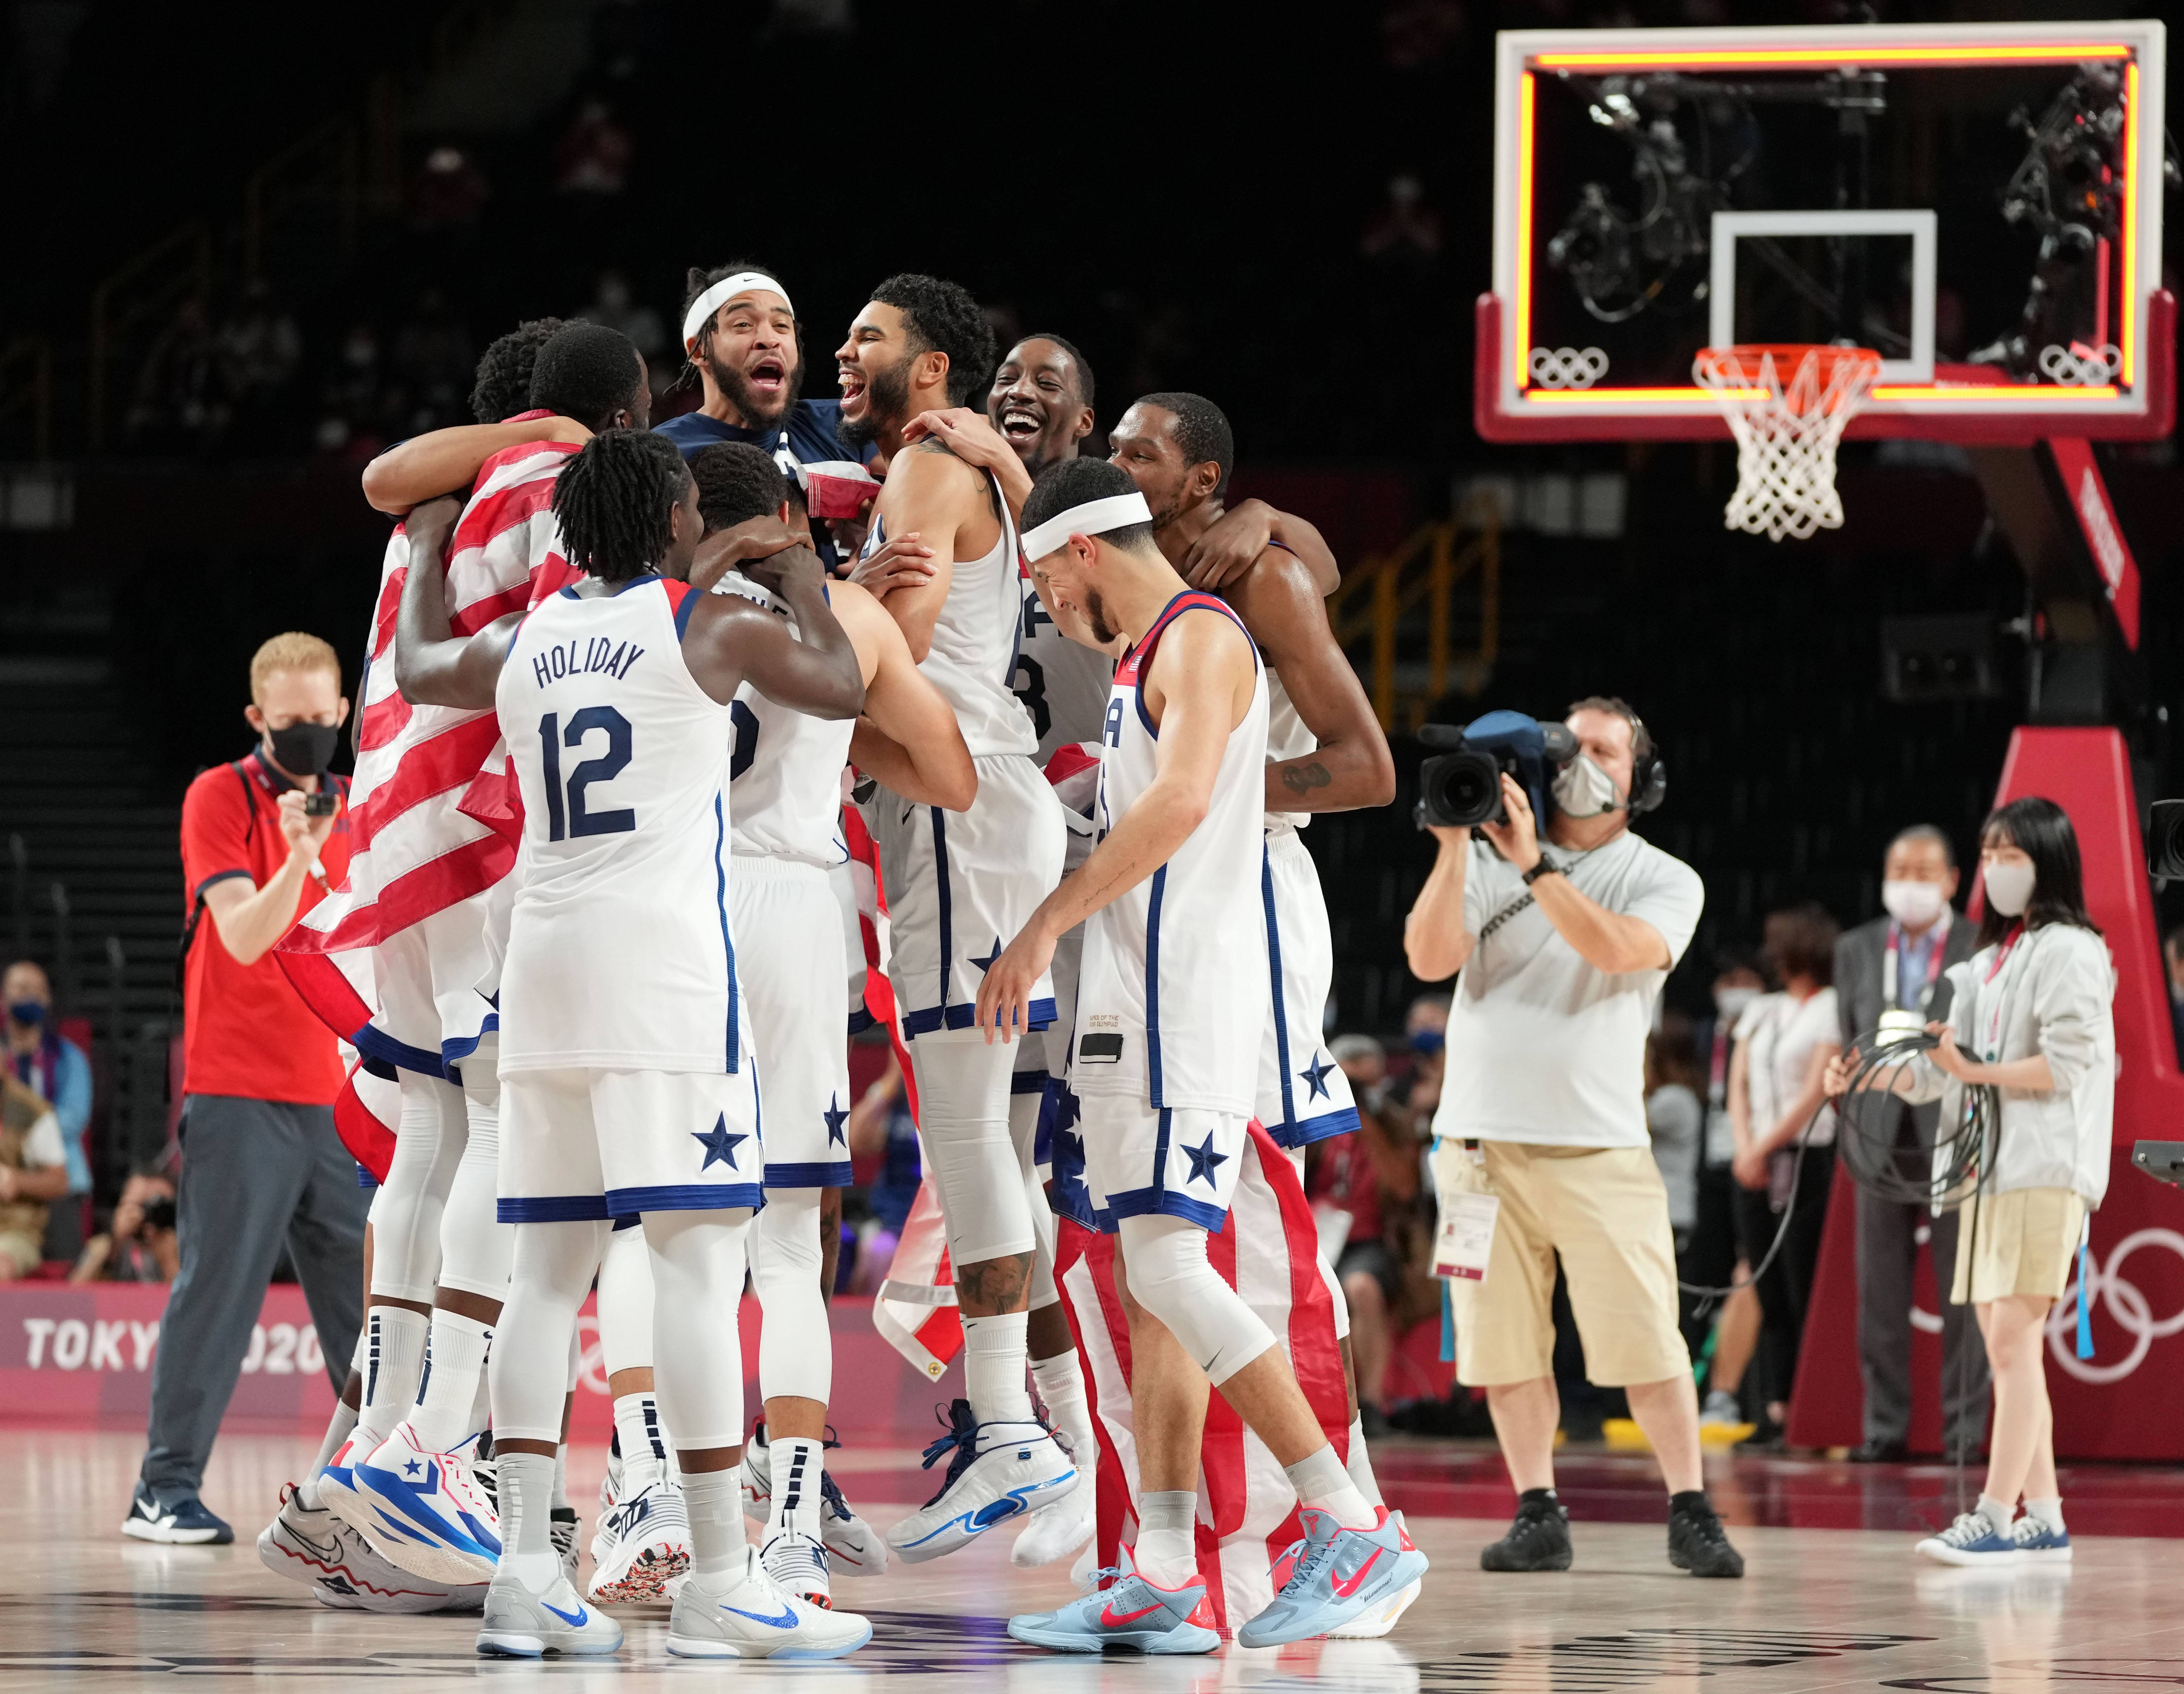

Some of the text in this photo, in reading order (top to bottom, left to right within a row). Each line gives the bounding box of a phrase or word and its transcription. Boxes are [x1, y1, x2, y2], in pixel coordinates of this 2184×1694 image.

[532, 637, 645, 690] HOLIDAY
[538, 705, 636, 842] 12
[22, 1318, 160, 1372] TOKY
